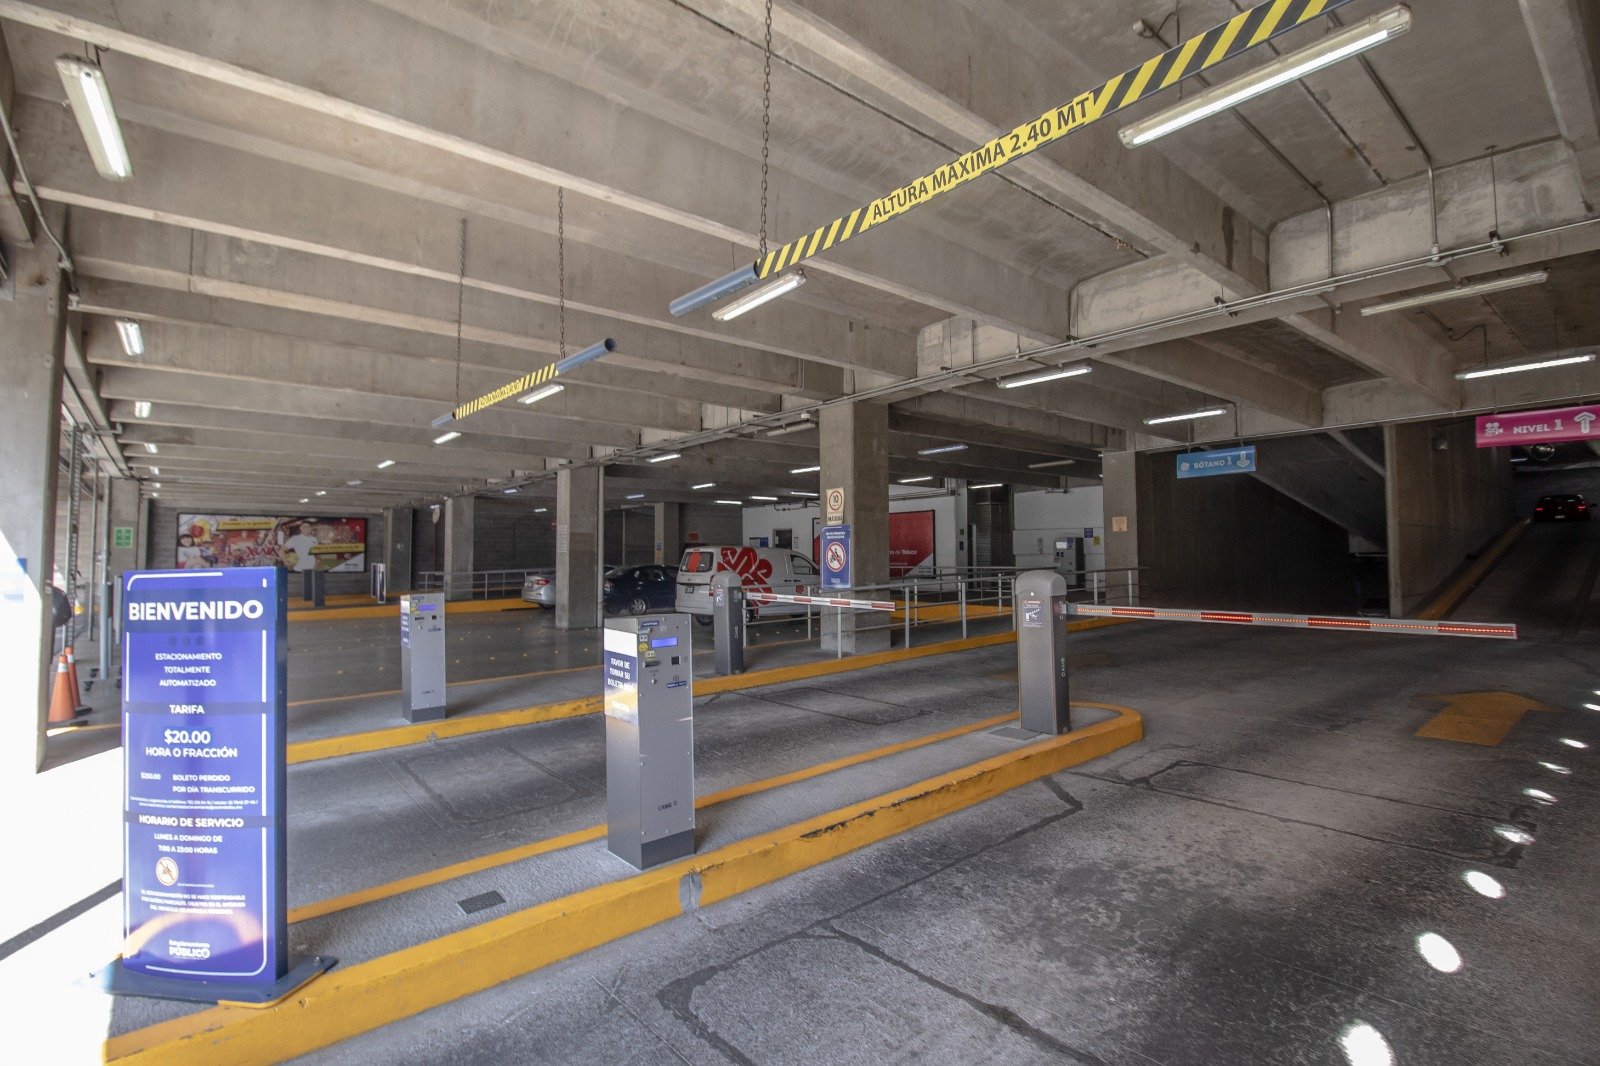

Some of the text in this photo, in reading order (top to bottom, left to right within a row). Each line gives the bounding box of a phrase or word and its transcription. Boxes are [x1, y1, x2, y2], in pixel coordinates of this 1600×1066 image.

[872, 97, 1090, 220] ALTURA MAXIMA 2.40 MT
[1513, 419, 1563, 434] NIVEL 1
[128, 599, 264, 621] BIENVENIDO
[155, 652, 222, 661] ESTACIONAMIENTO
[164, 665, 211, 674] TOTALMENTE
[159, 679, 217, 687] AUTOMATIZADO
[169, 704, 205, 715] TARIFA
[164, 728, 212, 745] $20.00
[145, 746, 238, 758] HORA O FRACCIÓN
[172, 774, 231, 782] BOLETO PERDIDO
[138, 814, 244, 828] HORARIO DE SERVICIO
[154, 833, 174, 841] LUNES
[213, 835, 223, 843] DE
